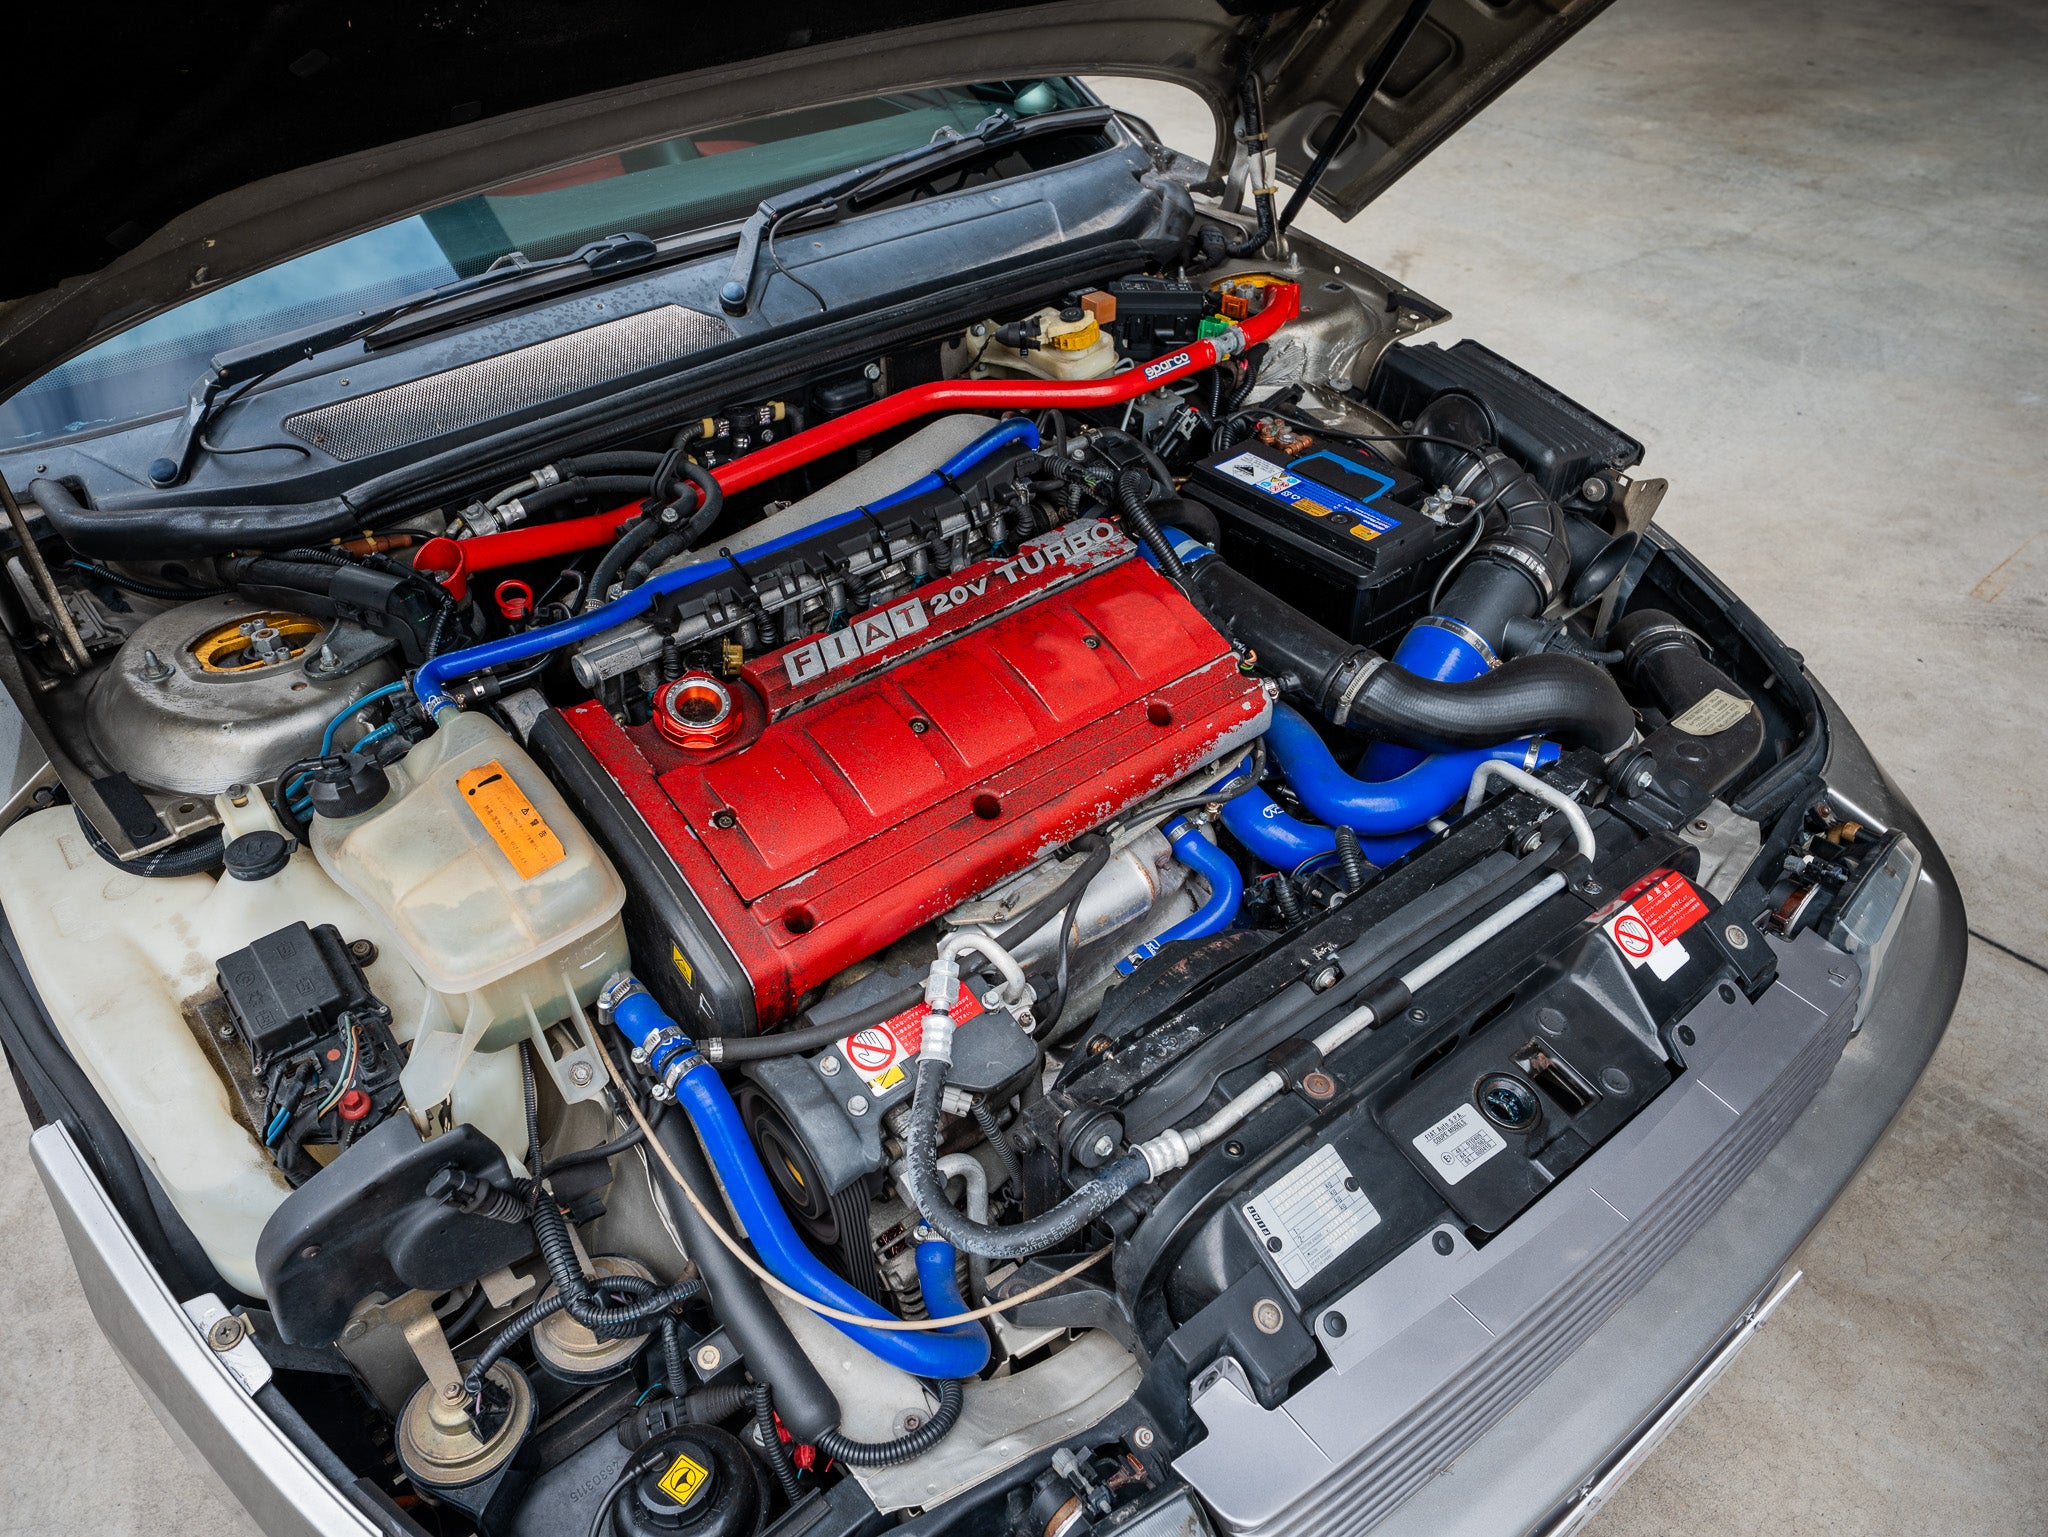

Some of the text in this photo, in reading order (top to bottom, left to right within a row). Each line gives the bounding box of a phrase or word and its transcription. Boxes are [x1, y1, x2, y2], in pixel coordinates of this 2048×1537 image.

[1144, 352, 1189, 378] sparco
[788, 600, 924, 682] FIAT
[994, 522, 1115, 584] TURBO
[570, 1460, 620, 1502] 46303115
